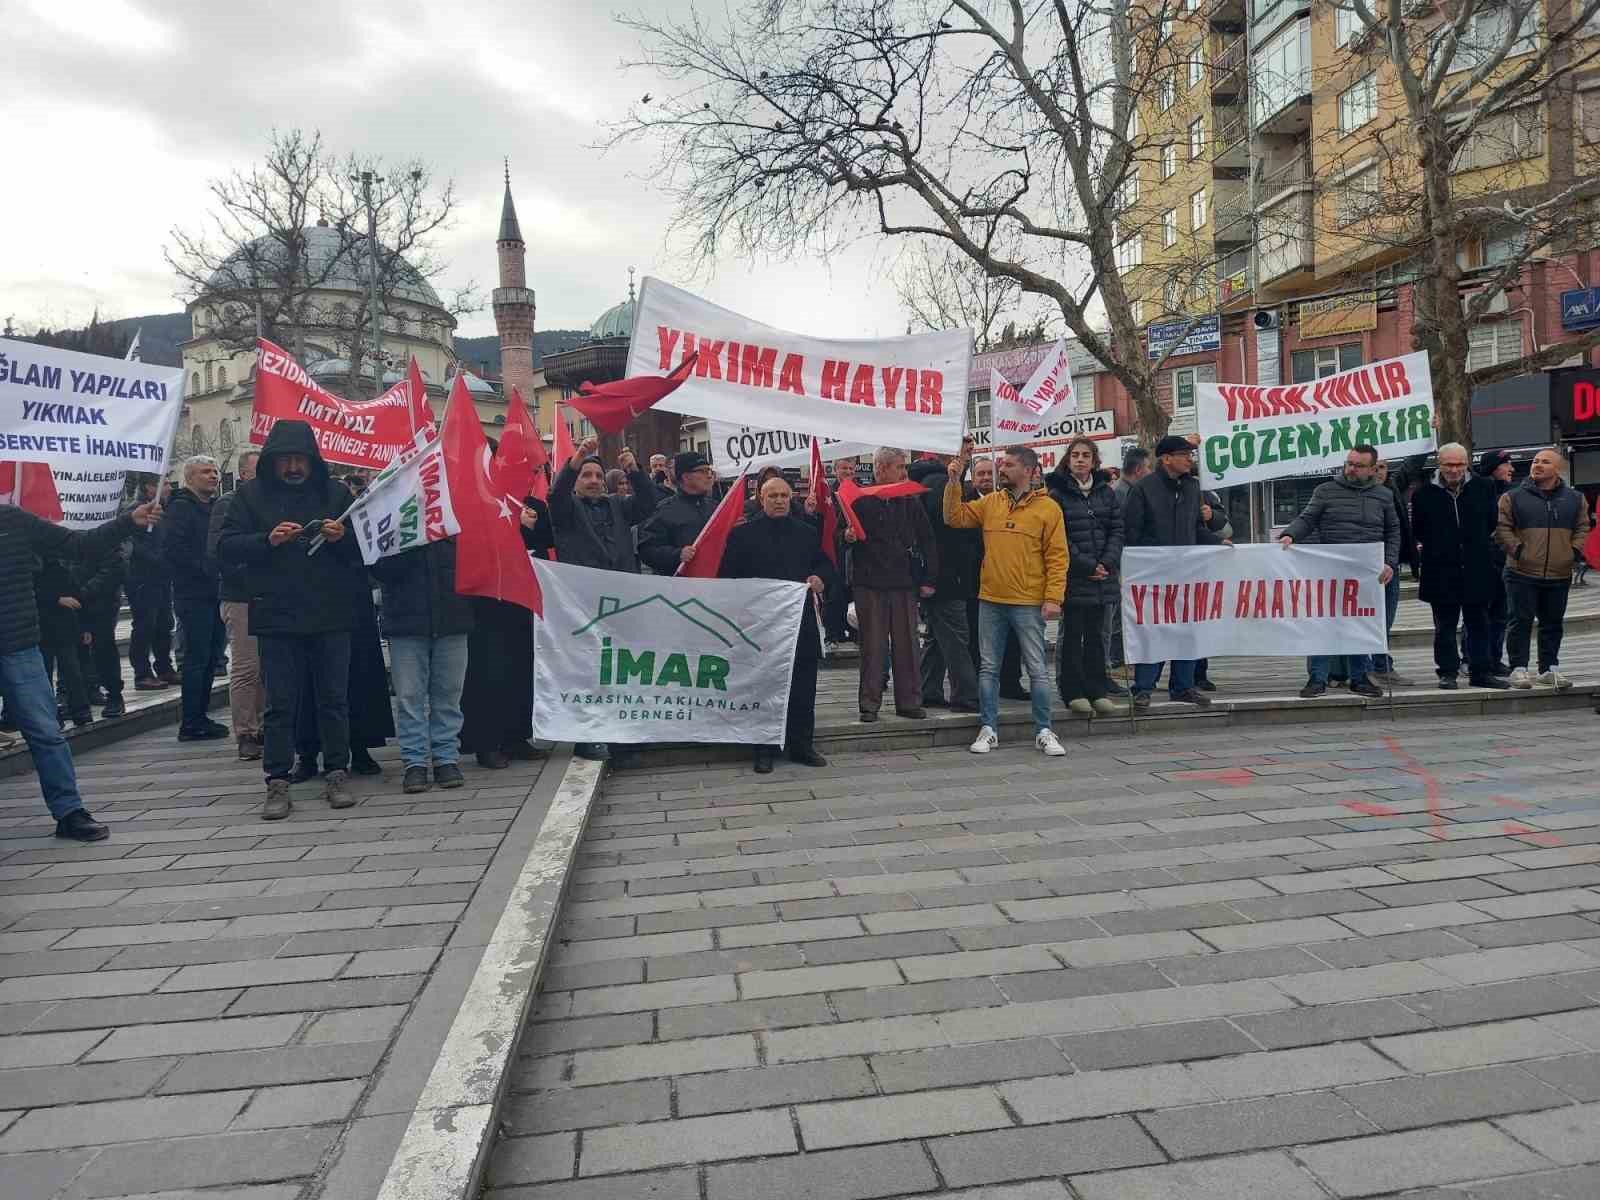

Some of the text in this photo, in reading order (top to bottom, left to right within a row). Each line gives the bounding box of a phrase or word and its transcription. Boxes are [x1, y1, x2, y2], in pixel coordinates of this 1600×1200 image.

[70, 370, 167, 401] YAPILARI
[657, 326, 945, 416] YIKIMA HAYIR
[22, 400, 108, 426] YIKMAK
[298, 393, 376, 435] İMTİYAZ
[0, 433, 164, 465] SERVETE İHANETTİR
[1131, 579, 1376, 625] YIKIMA HAAYIIIR...
[599, 636, 730, 691] İMAR
[560, 693, 761, 711] YASASINA TAKILANLAR
[618, 708, 693, 721] DERNEĞİ
